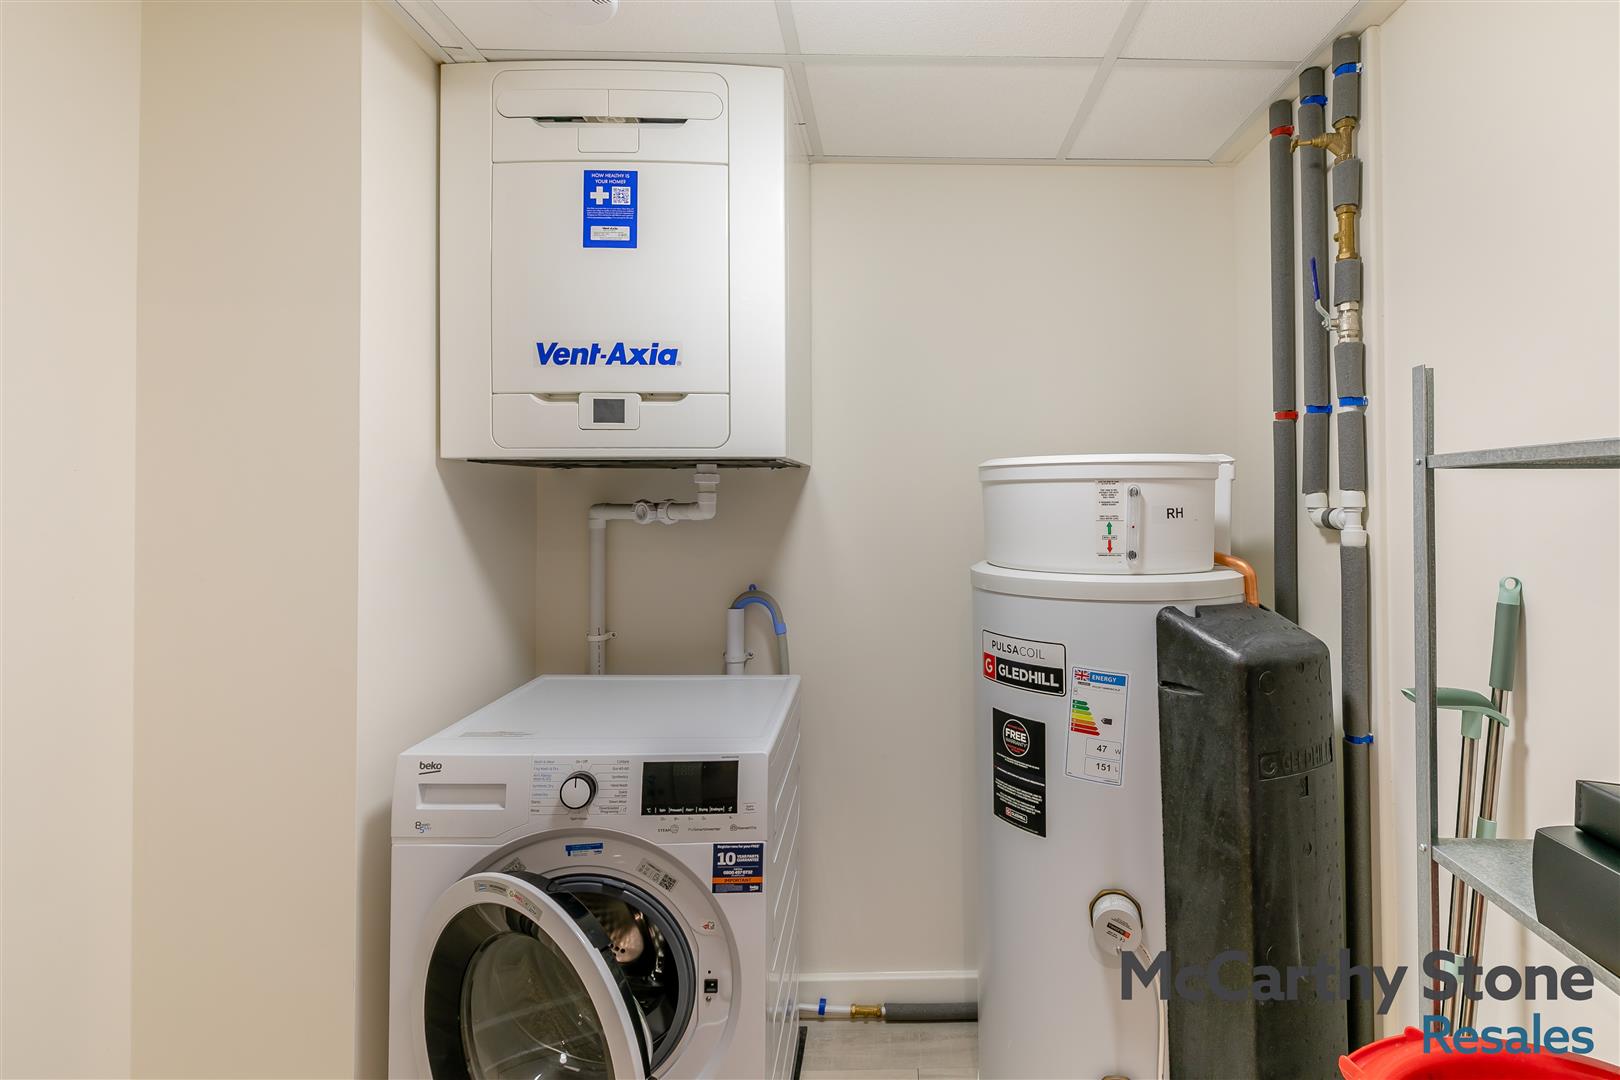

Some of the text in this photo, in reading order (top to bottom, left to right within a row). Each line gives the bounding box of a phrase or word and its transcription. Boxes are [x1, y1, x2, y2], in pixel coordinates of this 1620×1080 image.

[536, 342, 678, 366] Vent-Axia
[1166, 507, 1184, 519] RH
[992, 640, 1045, 660] PULSACOIL
[985, 658, 1060, 688] G GLEDHILL
[1092, 674, 1117, 684] ENERGY
[1005, 727, 1027, 743] FREE
[1096, 744, 1108, 753] 47
[420, 761, 442, 770] beko
[1096, 762, 1111, 772] 151
[414, 820, 422, 830] 8
[717, 852, 736, 866] 10
